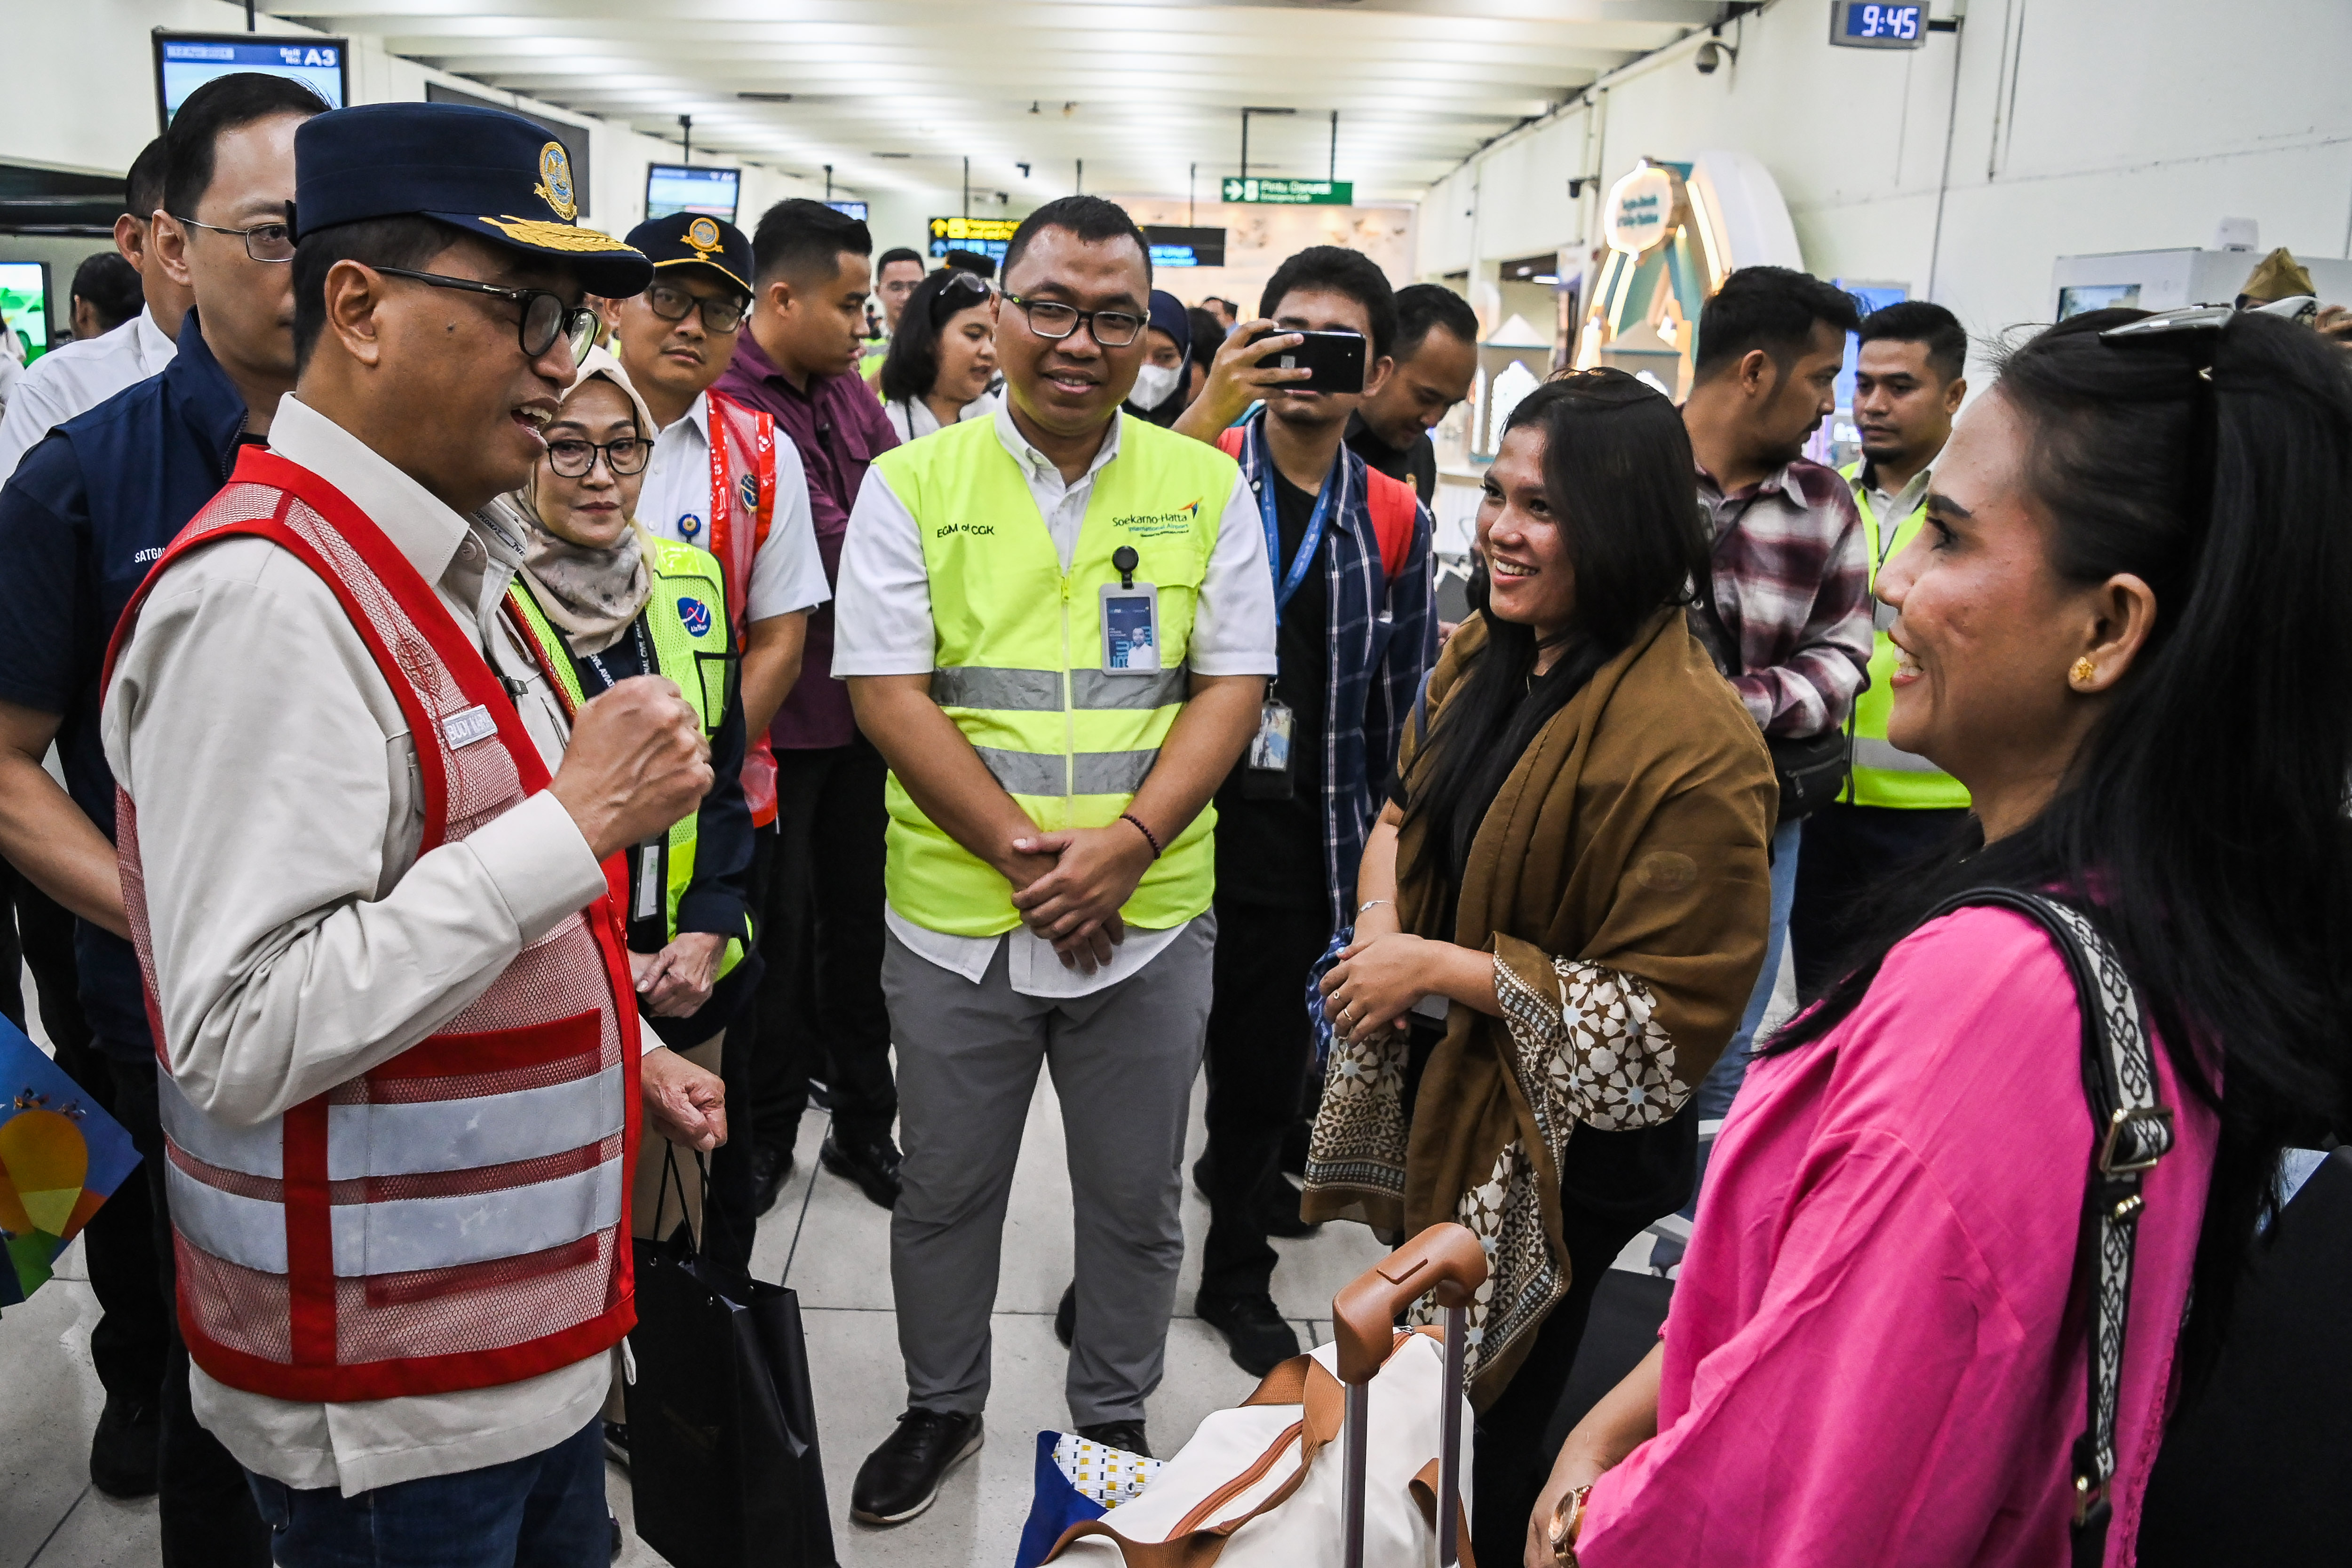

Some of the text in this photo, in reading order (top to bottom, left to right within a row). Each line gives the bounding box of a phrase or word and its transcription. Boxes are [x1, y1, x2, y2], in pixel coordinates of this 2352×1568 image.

[1861, 5, 1918, 39] 9:45
[304, 48, 336, 66] A3
[937, 523, 994, 538] EGM of CGK
[598, 668, 615, 687] AVIAT
